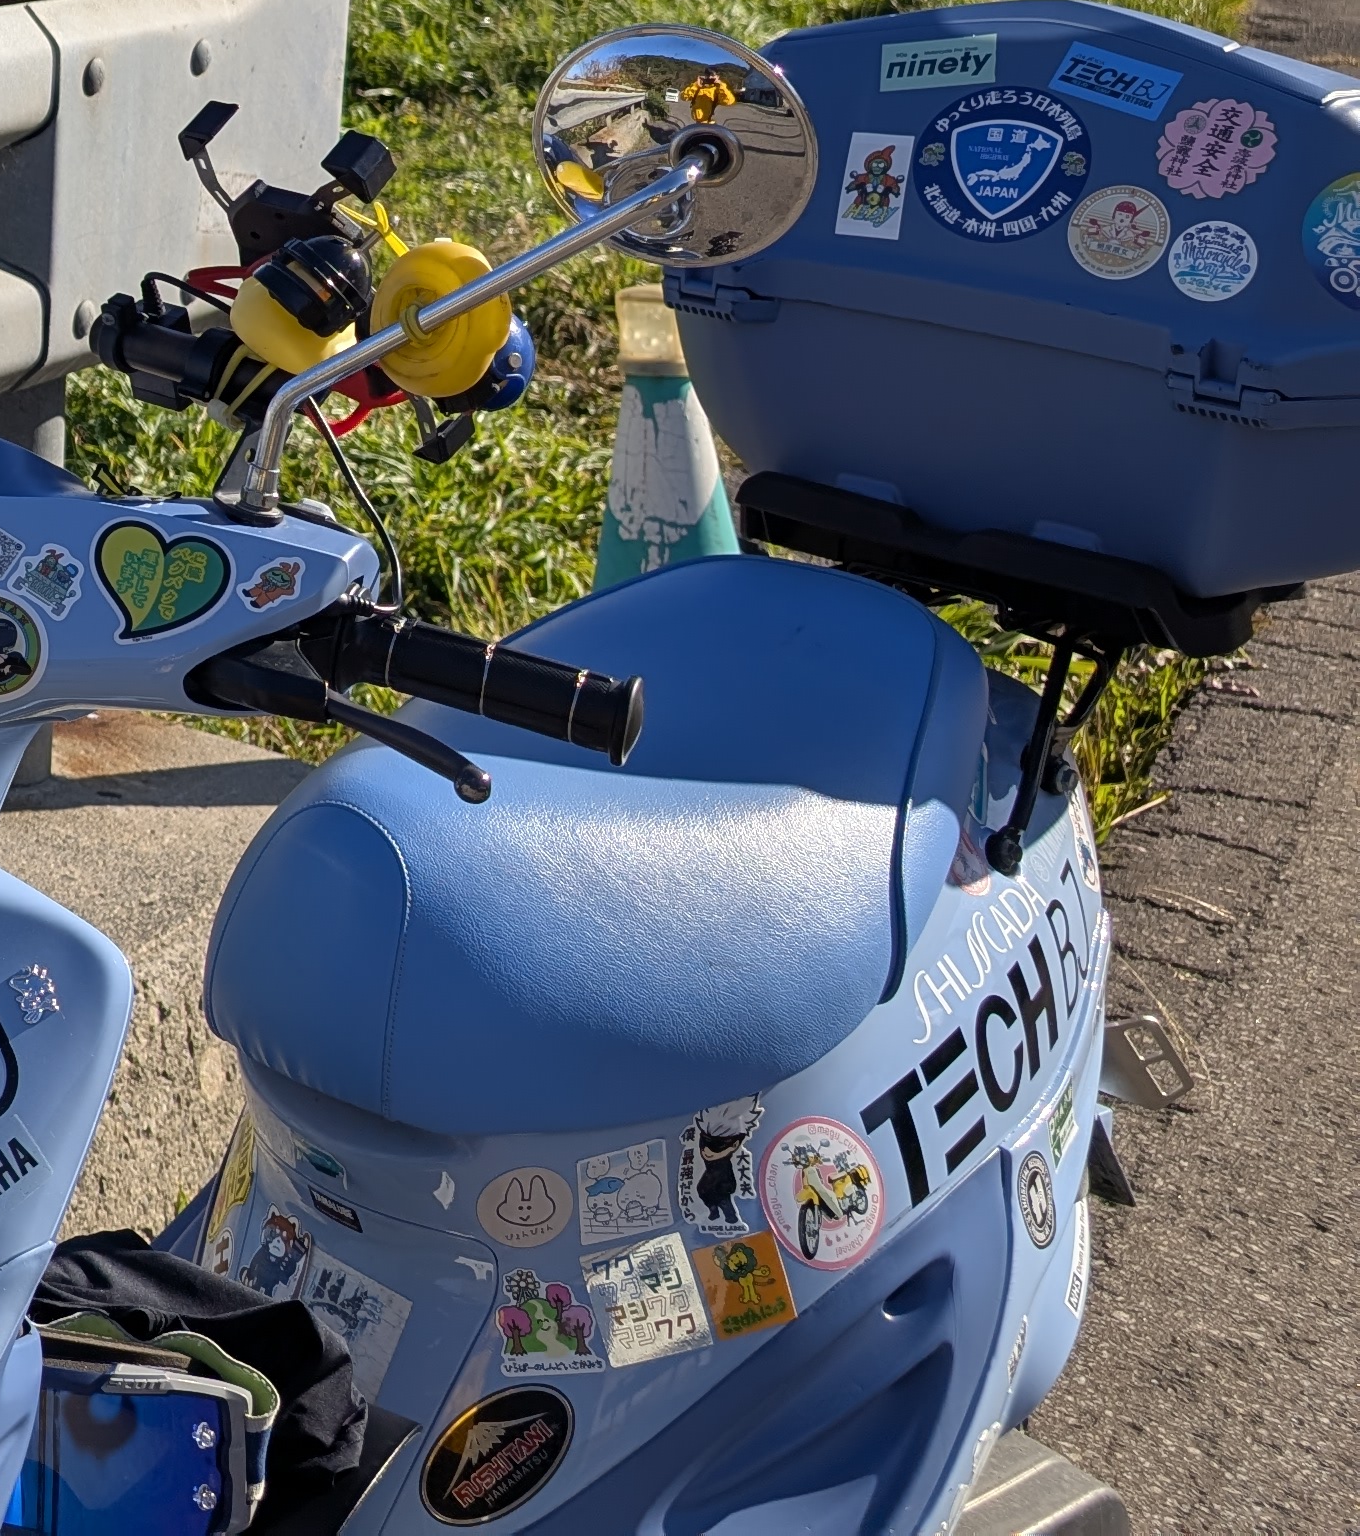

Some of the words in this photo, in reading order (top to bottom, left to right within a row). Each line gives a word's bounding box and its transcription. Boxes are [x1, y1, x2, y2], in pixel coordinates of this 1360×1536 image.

[885, 51, 993, 79] ninety
[1064, 56, 1139, 93] TECH
[1133, 78, 1171, 101] BJ
[935, 89, 1083, 142] ゆっくり走ろう日本列島
[967, 144, 1004, 155] NATIONAL
[979, 152, 1010, 162] HIGHWAY
[1191, 106, 1244, 178] 交通安全
[975, 185, 1019, 199] JAPAN
[859, 932, 1059, 1210] TECH
[680, 1126, 697, 1143] 僕
[680, 1148, 697, 1222] 最強だから
[1075, 1253, 1084, 1274] Drum
[1068, 1274, 1082, 1312] NHS
[108, 1377, 165, 1390] SCOTT
[484, 1448, 550, 1506] HAMAMATSU
